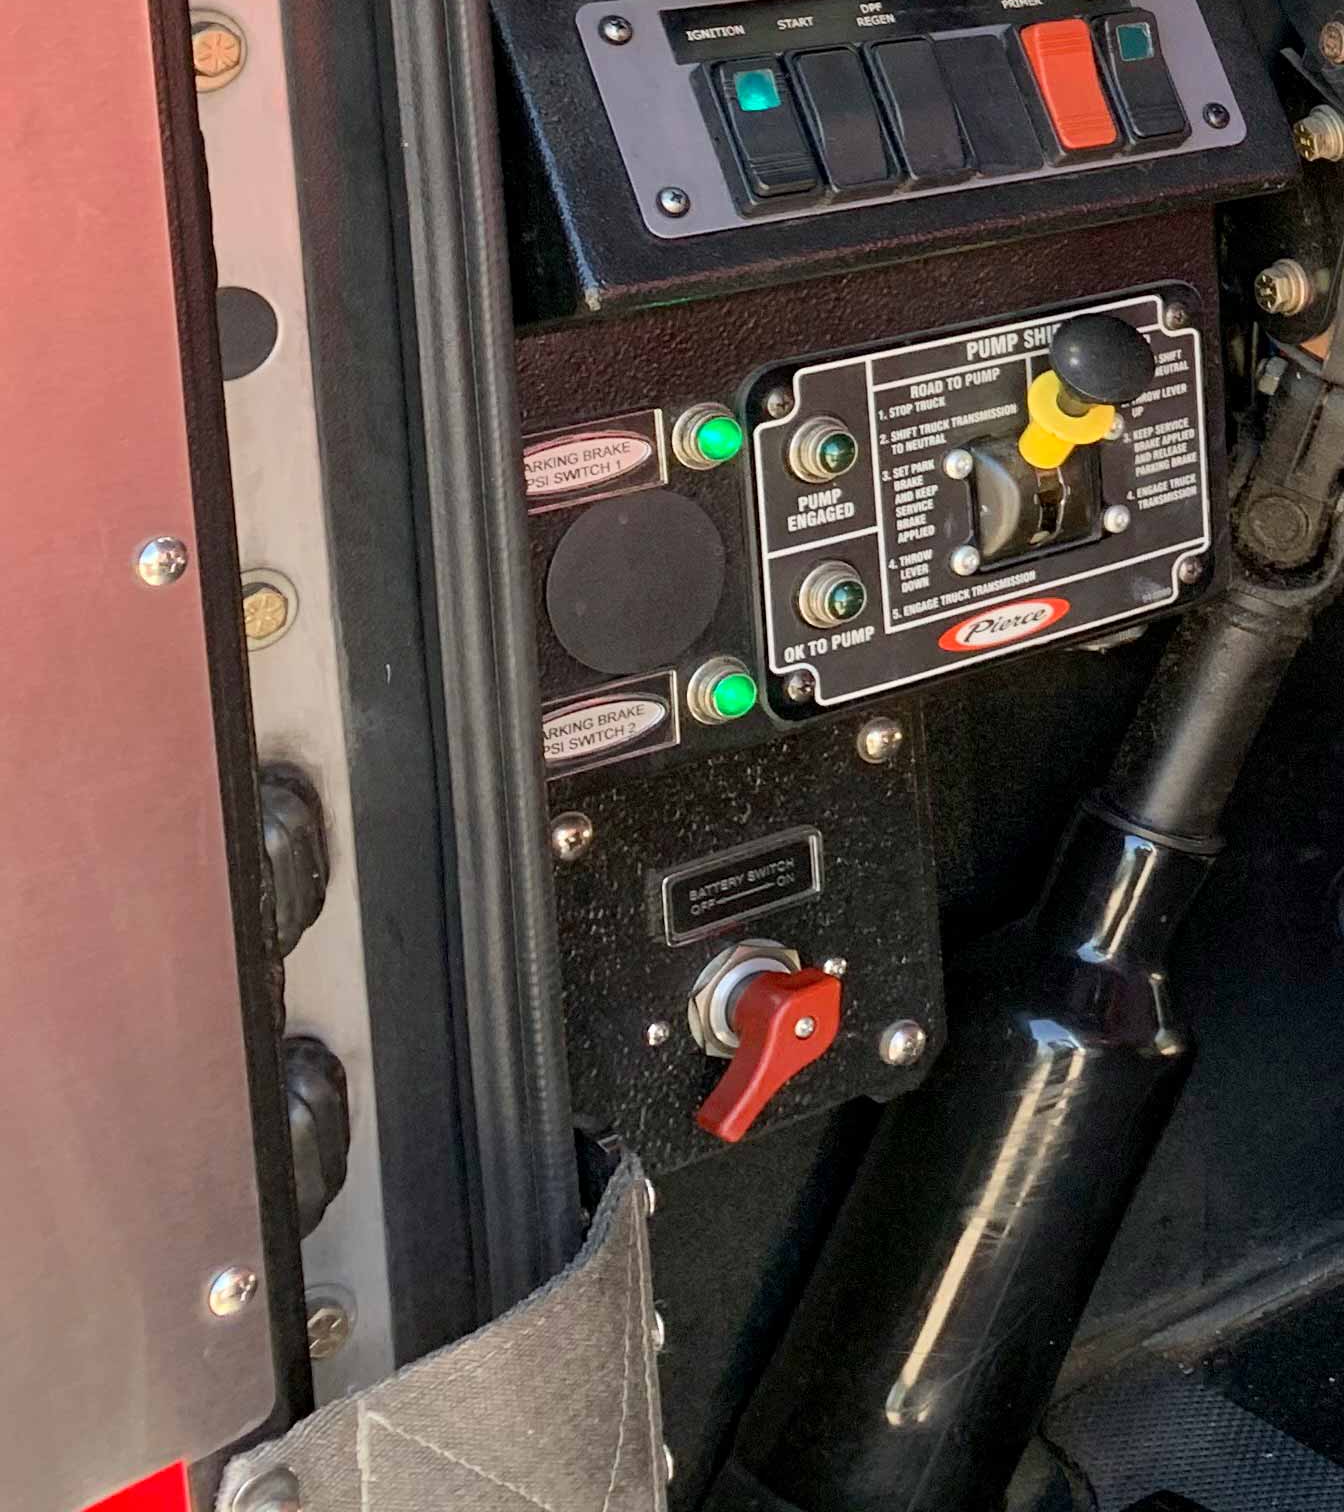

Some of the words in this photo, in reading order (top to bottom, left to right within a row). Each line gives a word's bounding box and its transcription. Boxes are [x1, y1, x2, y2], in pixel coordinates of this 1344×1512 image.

[859, 2, 882, 14] DPF
[686, 24, 746, 41] IGNITION
[777, 16, 814, 30] START
[856, 14, 896, 27] REGEN
[966, 333, 1018, 361] PUMP
[1023, 324, 1058, 349] SHI
[1159, 349, 1182, 364] SHIFT
[910, 380, 943, 399] ROAD
[946, 376, 962, 391] TO
[965, 367, 1000, 387] PUMP
[1162, 383, 1187, 399] LEVER
[878, 410, 888, 420] 1.
[889, 403, 913, 419] STOP
[915, 396, 946, 413] TRUCK
[1132, 406, 1145, 418] UP
[879, 434, 889, 445] 2.
[890, 428, 917, 443] SHIFT
[919, 418, 950, 435] TRUCK
[951, 403, 1018, 429] TRANSMISSION
[1132, 425, 1154, 441] KEEP
[1155, 417, 1190, 435] SERVICE
[891, 444, 903, 455] TO
[905, 434, 947, 453] NEUTRAL
[1134, 436, 1161, 453] BRAKE
[1162, 428, 1195, 446] APPLIED
[524, 453, 579, 473] ARKING
[583, 441, 631, 460] BRAKE
[1135, 452, 1152, 465] AND
[1153, 442, 1188, 460] RELEASE
[1135, 459, 1171, 478] PARKING
[1171, 451, 1198, 469] BRAKE
[526, 474, 549, 489] PSI
[554, 462, 610, 484] SWITCH
[616, 460, 622, 470] 1
[882, 470, 892, 481] 3.
[893, 466, 910, 479] SET
[911, 459, 935, 475] PARK
[893, 475, 924, 491] BRAKE
[895, 492, 914, 505] AND
[915, 485, 939, 501] KEEP
[1137, 481, 1170, 499] ENGAGE
[1170, 473, 1197, 489] TRUCK
[798, 488, 843, 512] PUMP
[895, 499, 934, 518] SERVICE
[1137, 486, 1198, 510] TRANSMISSION
[787, 502, 855, 532] ENGAGED
[896, 513, 927, 531] BRAKE
[897, 525, 936, 544] APPLIED
[888, 559, 898, 569] 4.
[899, 549, 933, 567] THROW
[900, 563, 929, 580] LEVER
[891, 608, 902, 619] 5.
[903, 597, 939, 617] ENGAGE
[941, 588, 970, 606] TRUCK
[971, 570, 1036, 599] TRANSMISSION
[901, 576, 930, 593] DOWN
[963, 606, 1046, 644] Pierce
[783, 646, 805, 663] OK
[806, 638, 829, 657] TO
[831, 625, 875, 651] PUMP
[542, 719, 593, 740] ARKING
[597, 704, 646, 725] BRAKE
[569, 725, 625, 750] SWITCH
[627, 722, 636, 734] 2
[689, 873, 745, 901] BATTERY
[747, 858, 795, 882] SWITCH
[690, 898, 716, 916] OFF
[776, 872, 795, 887] ON
